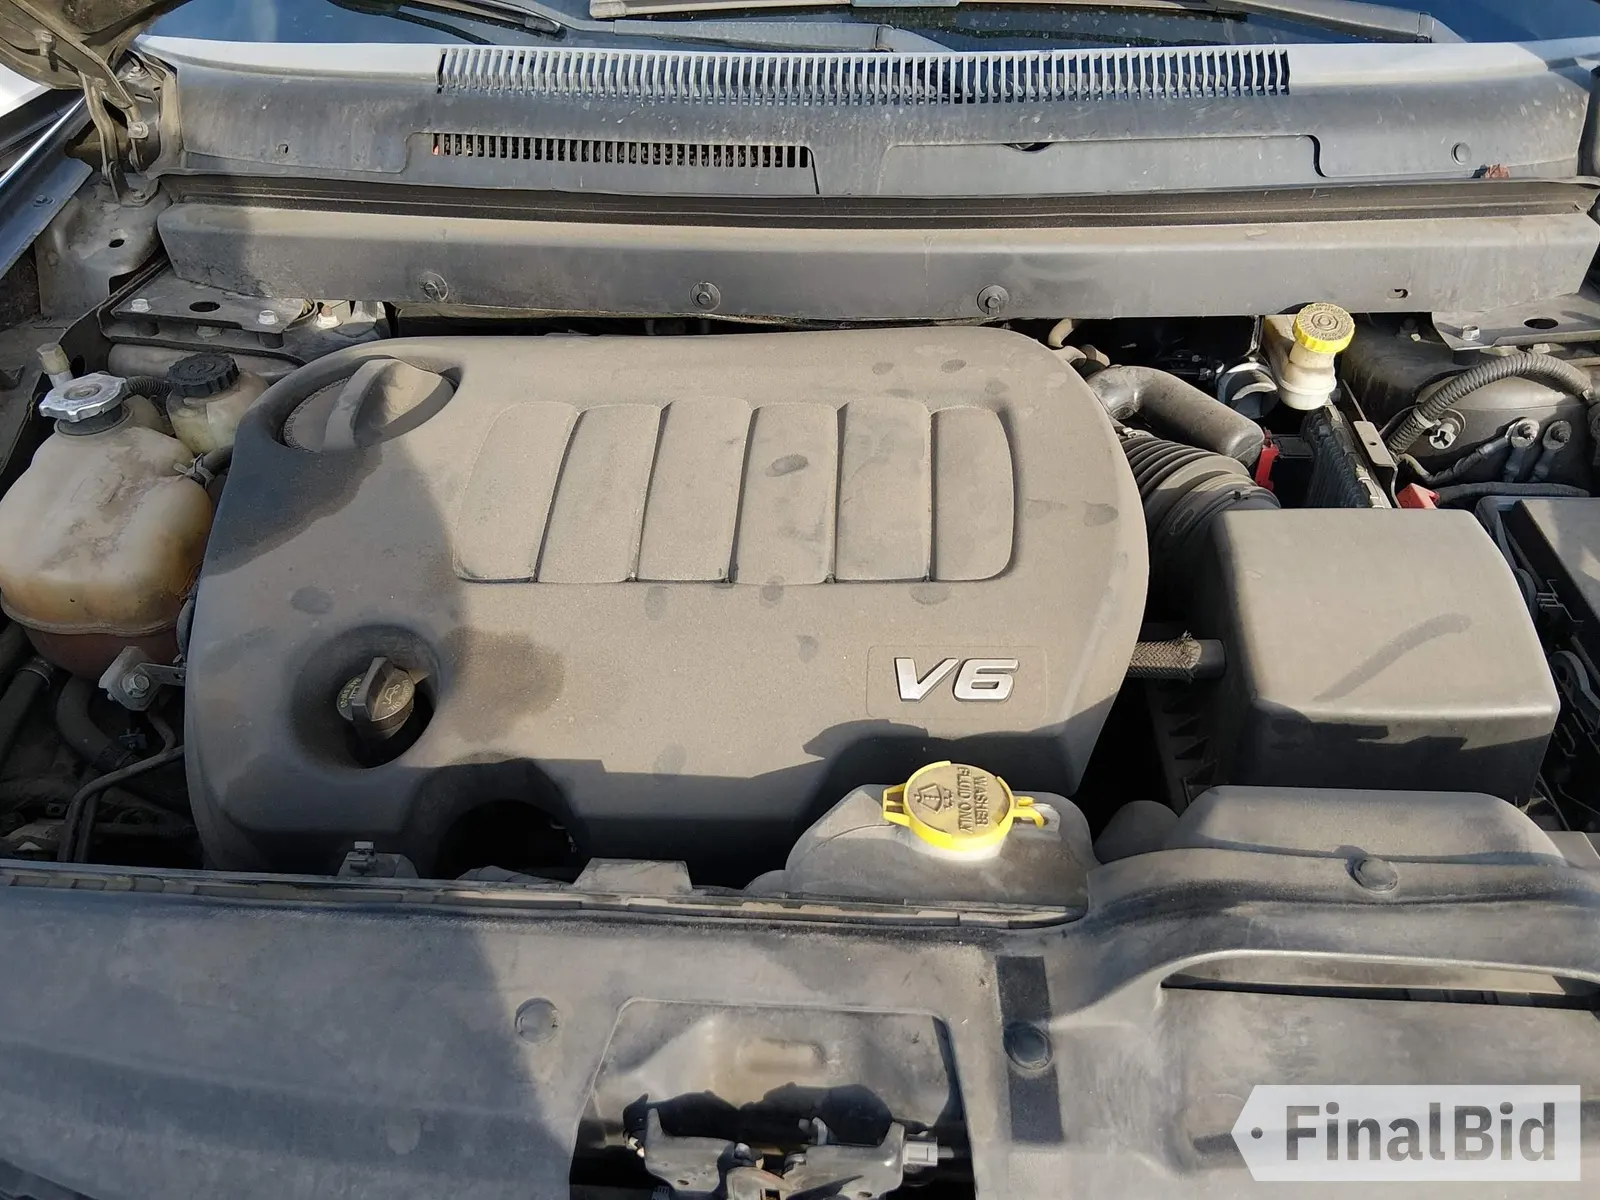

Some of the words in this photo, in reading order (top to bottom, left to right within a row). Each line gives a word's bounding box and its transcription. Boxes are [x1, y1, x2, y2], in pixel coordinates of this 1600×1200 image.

[894, 657, 1019, 702] V6
[388, 701, 402, 711] OIL
[957, 766, 972, 800] FLUID
[958, 801, 973, 835] ONLY
[974, 775, 989, 827] WASHER
